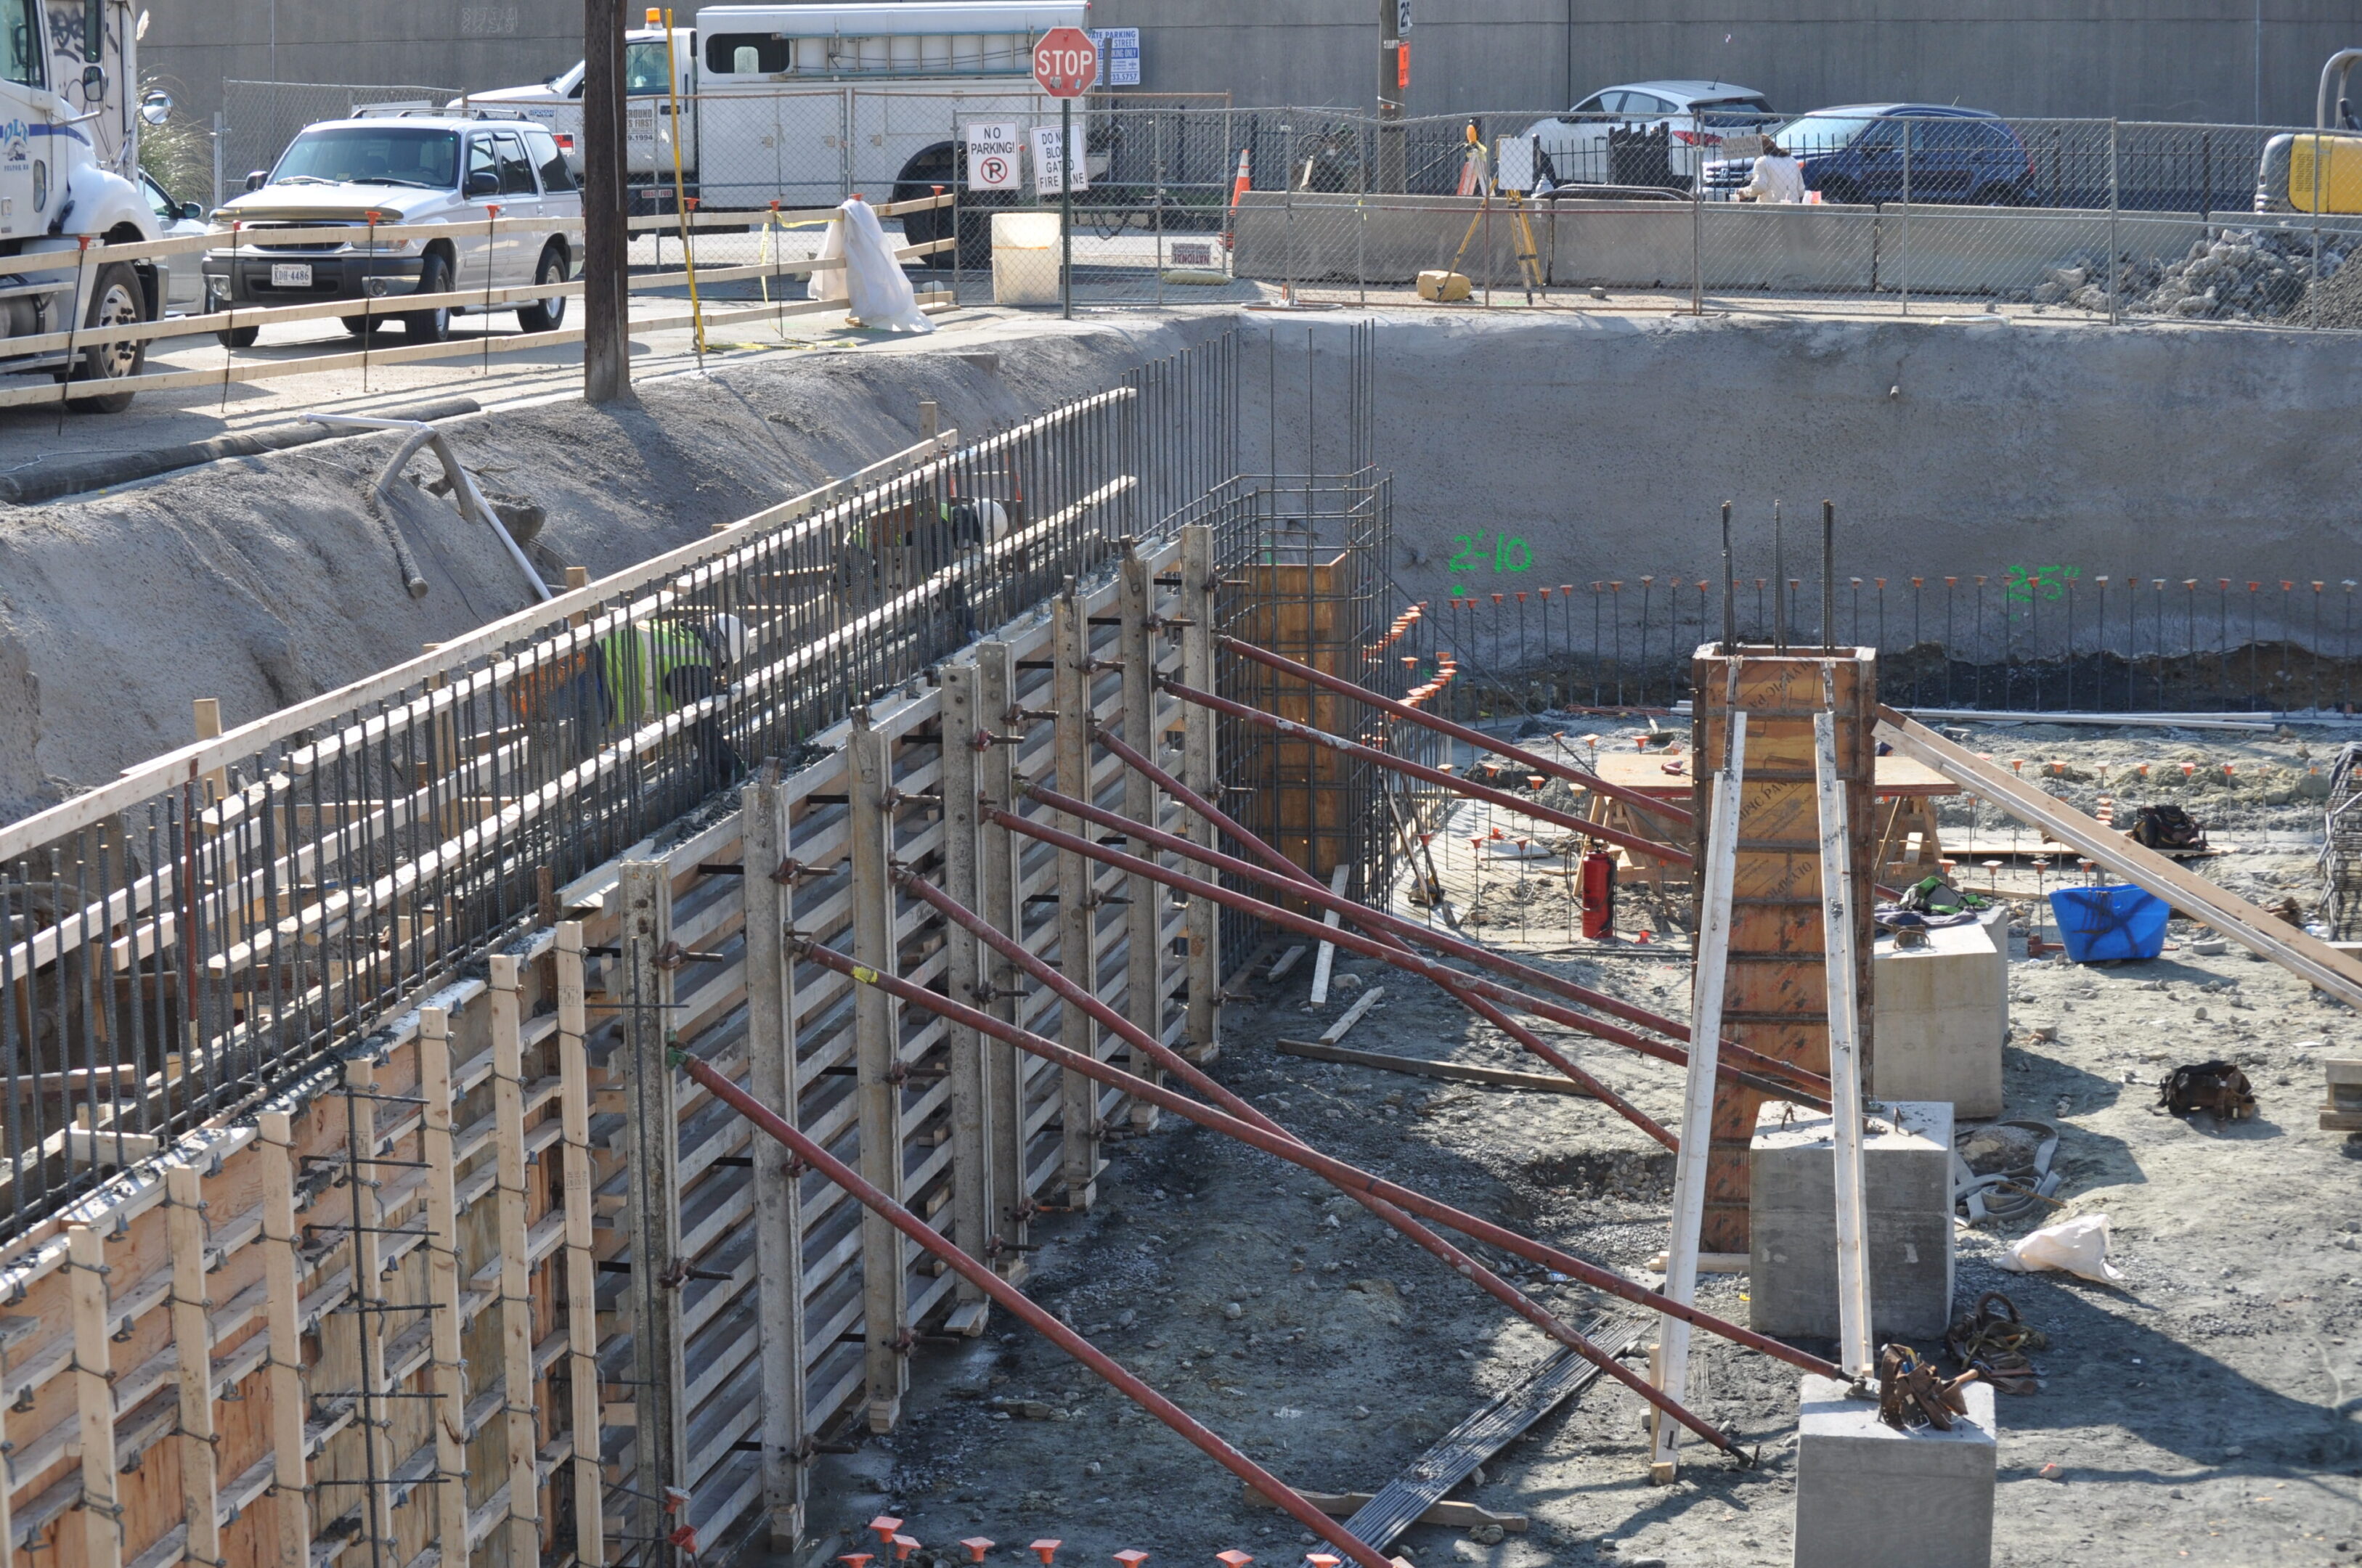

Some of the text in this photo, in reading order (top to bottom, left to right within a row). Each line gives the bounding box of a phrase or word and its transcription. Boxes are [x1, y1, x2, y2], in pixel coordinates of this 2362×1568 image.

[1105, 30, 1136, 39] PARKING
[1038, 49, 1093, 75] STOP
[984, 127, 1001, 139] NO
[1042, 133, 1053, 144] DO
[971, 142, 1015, 155] PARKING!
[1046, 147, 1064, 159] BLO
[1046, 159, 1075, 173] GATD
[1040, 176, 1059, 188] FIRE
